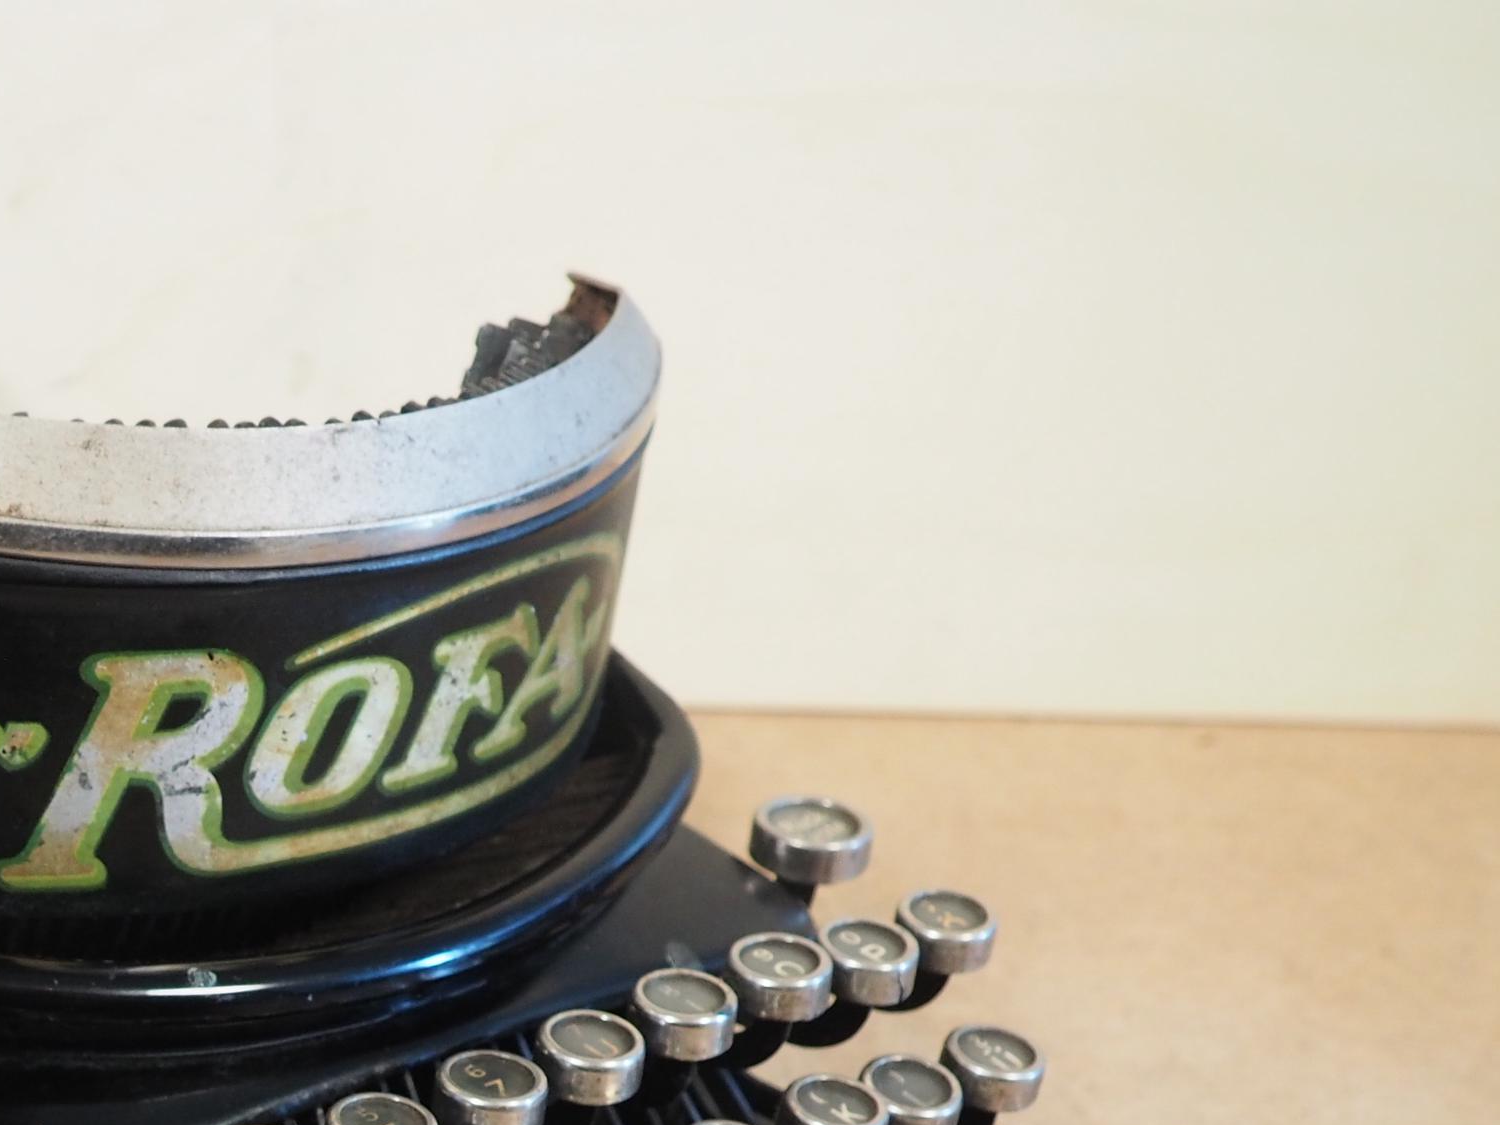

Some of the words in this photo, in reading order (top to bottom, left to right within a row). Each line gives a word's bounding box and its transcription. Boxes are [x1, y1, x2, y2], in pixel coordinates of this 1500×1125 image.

[464, 1063, 486, 1079] 6
[357, 1108, 381, 1122] 5
[831, 1102, 866, 1124] K
